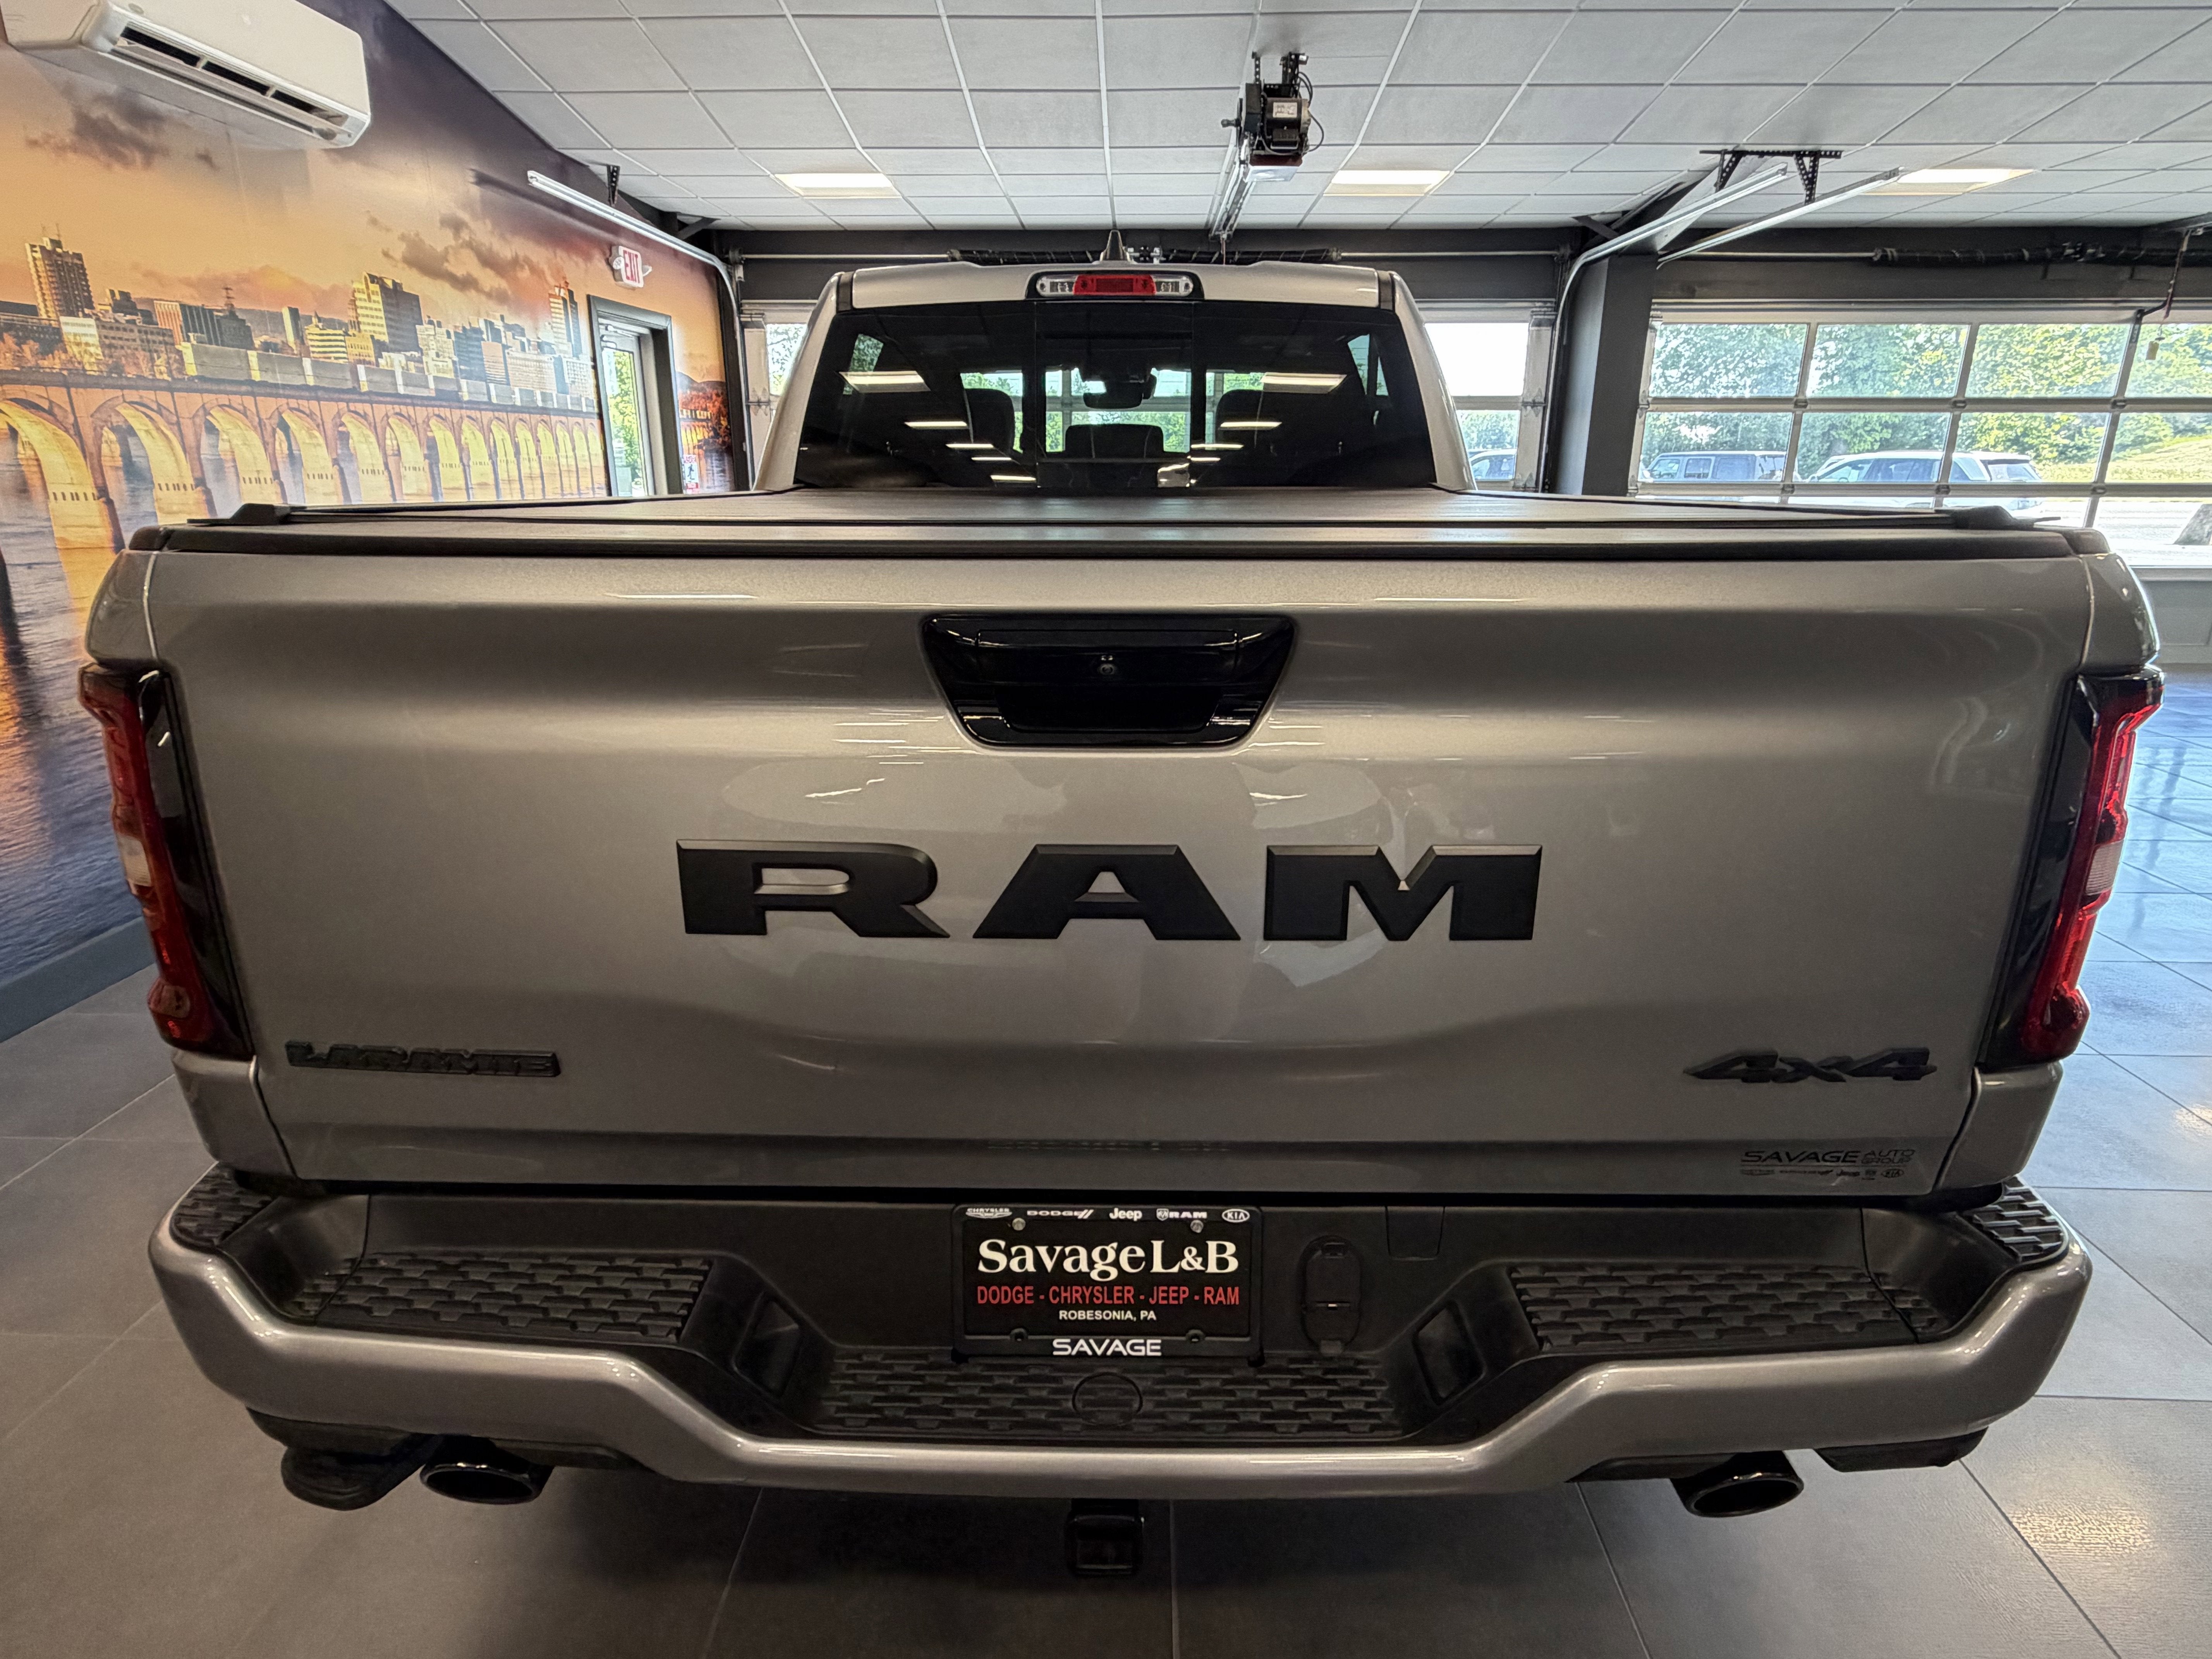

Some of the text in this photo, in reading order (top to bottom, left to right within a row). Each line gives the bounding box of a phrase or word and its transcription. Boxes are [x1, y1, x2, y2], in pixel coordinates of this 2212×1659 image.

[623, 250, 640, 283] EXIT
[676, 839, 1543, 941] RAM
[1741, 1149, 1915, 1163] SAVAGE AUTO
[1109, 1207, 1142, 1221] Jeep
[1225, 1211, 1247, 1221] KIA
[978, 1239, 1239, 1281] Savage L&B
[977, 1286, 1034, 1304] DODGE
[1049, 1286, 1135, 1304] CHRYSLER
[1149, 1286, 1189, 1304] JEEP
[1204, 1286, 1239, 1305] RAM
[1059, 1310, 1157, 1321] ROBESONIA, PA
[1053, 1338, 1162, 1356] SAVAGE
